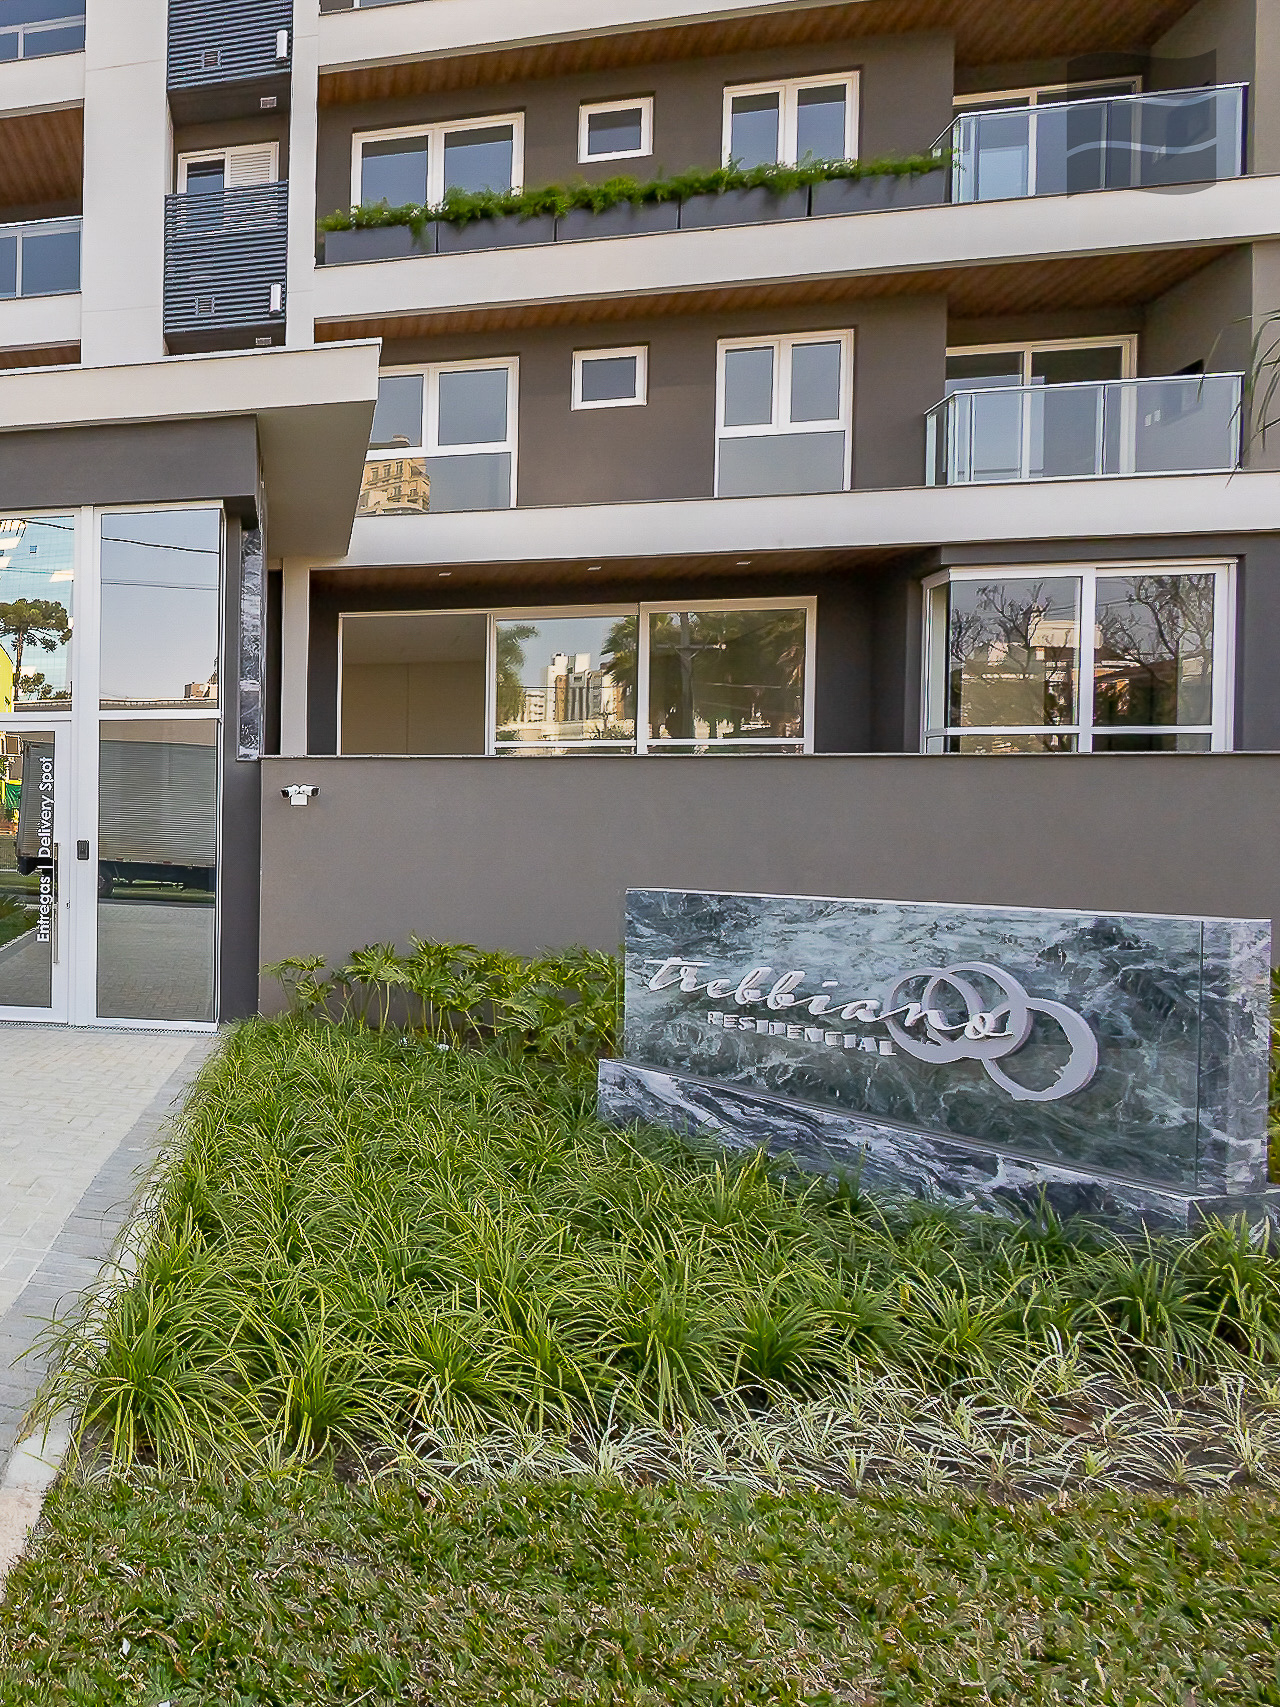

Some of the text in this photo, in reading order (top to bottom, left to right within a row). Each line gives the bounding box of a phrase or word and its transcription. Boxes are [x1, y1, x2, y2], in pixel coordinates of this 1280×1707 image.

[39, 756, 55, 792] Spot
[37, 795, 55, 858] Delivery
[36, 876, 53, 942] Entregas
[644, 957, 1014, 1040] trebbiano
[707, 1011, 897, 1056] RESIDENCIAL
